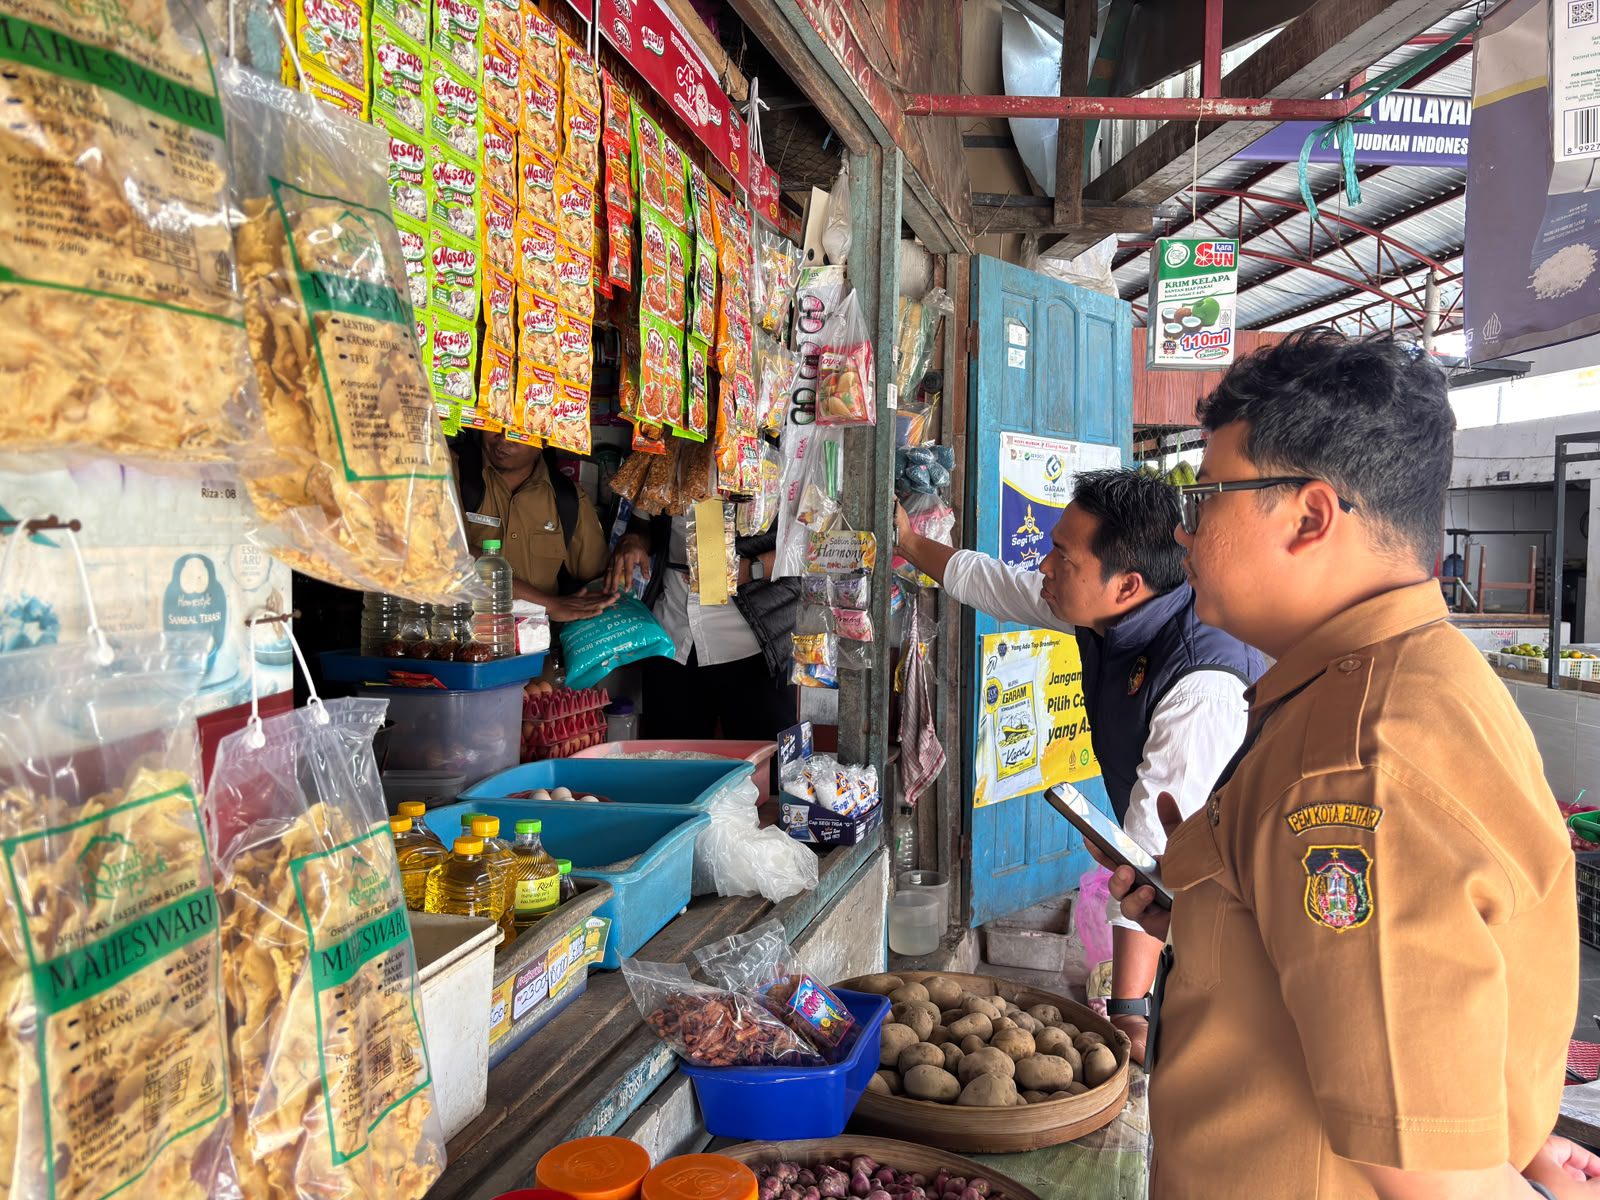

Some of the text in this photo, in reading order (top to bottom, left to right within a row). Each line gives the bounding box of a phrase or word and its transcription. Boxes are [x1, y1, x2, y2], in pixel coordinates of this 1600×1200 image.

[432, 247, 476, 269] Masako
[1194, 242, 1235, 268] SUN
[1165, 274, 1231, 289] KRIM KELAPA
[1182, 331, 1229, 350] 110ml
[201, 487, 219, 499] Riza
[225, 488, 237, 499] 08
[816, 544, 867, 564] Harmony
[167, 613, 198, 625] SAMBAL
[1048, 671, 1083, 687] Jangan
[1002, 686, 1027, 705] GARAM
[1047, 695, 1071, 714] Pilih
[1046, 724, 1076, 747] yang
[1290, 806, 1377, 830] PEM KOTA BLITAR
[164, 879, 197, 900] BLITAR
